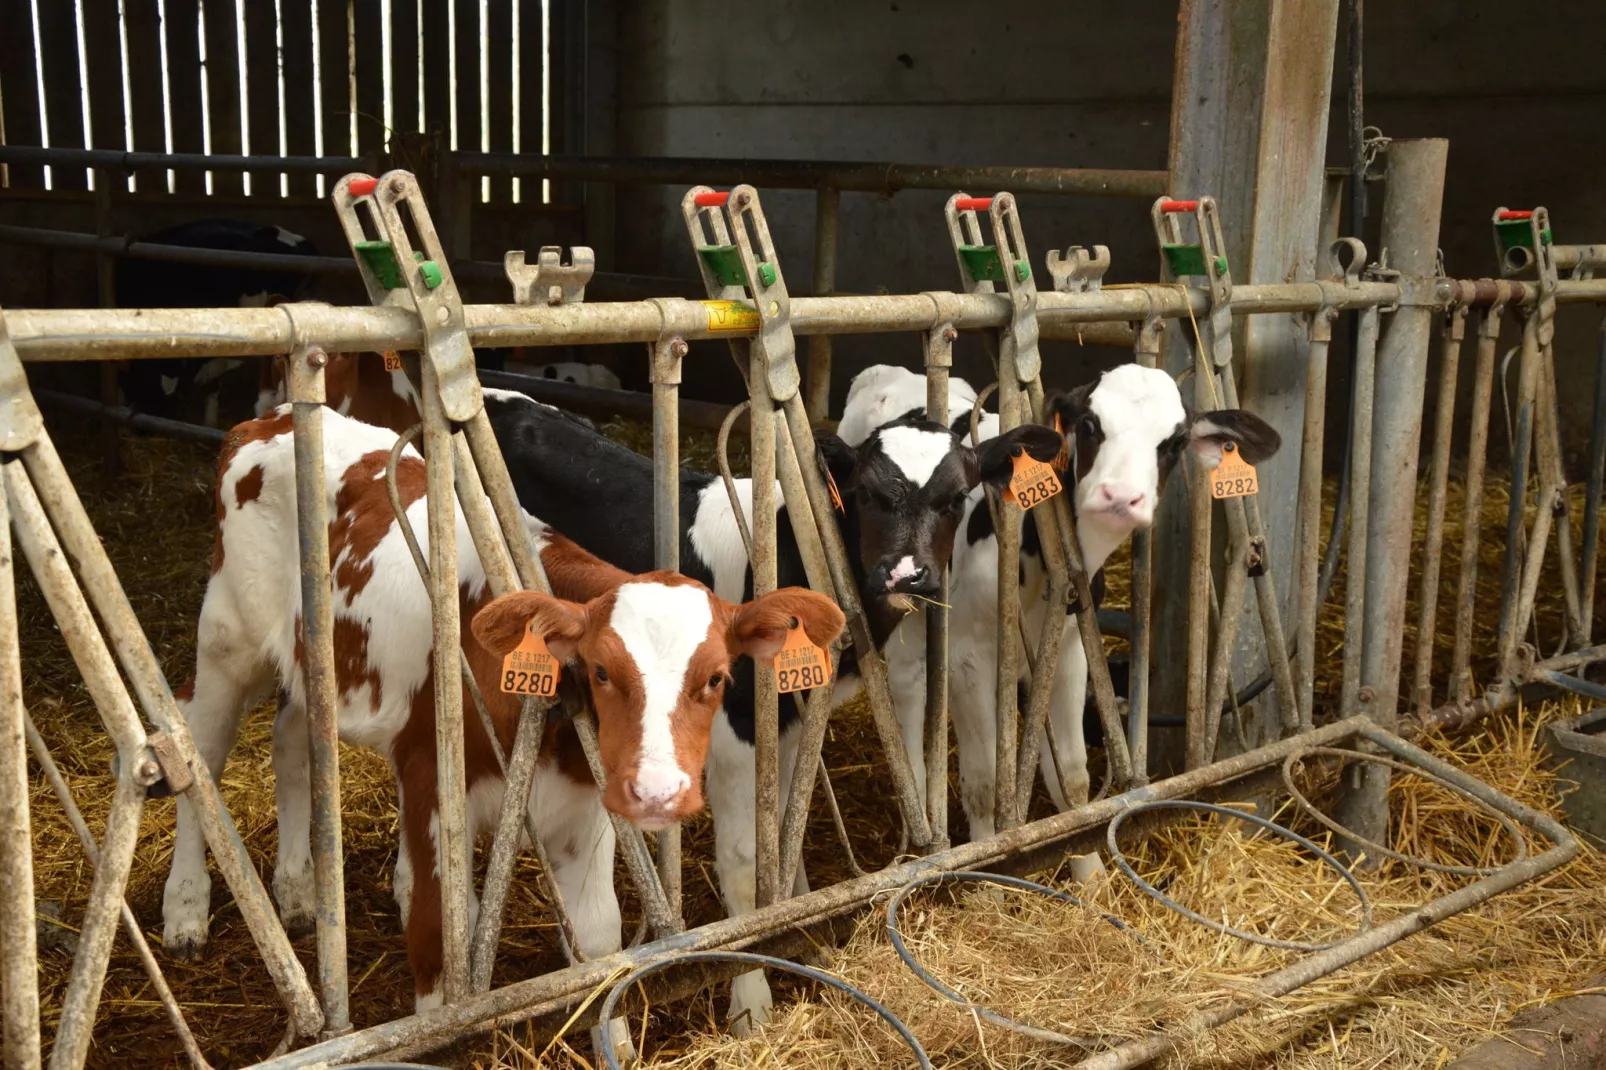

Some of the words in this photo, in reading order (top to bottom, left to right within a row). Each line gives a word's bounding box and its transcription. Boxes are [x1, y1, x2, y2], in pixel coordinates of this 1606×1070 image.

[386, 357, 401, 370] 82
[1018, 476, 1058, 508] 8283
[1215, 478, 1256, 496] 8282
[512, 651, 522, 661] BE
[526, 652, 531, 662] 2
[533, 653, 551, 663] 1217
[780, 649, 789, 660] BE
[792, 648, 797, 658] 2
[800, 645, 815, 657] 1217
[504, 670, 553, 695] 8280
[778, 665, 824, 691] 8280
